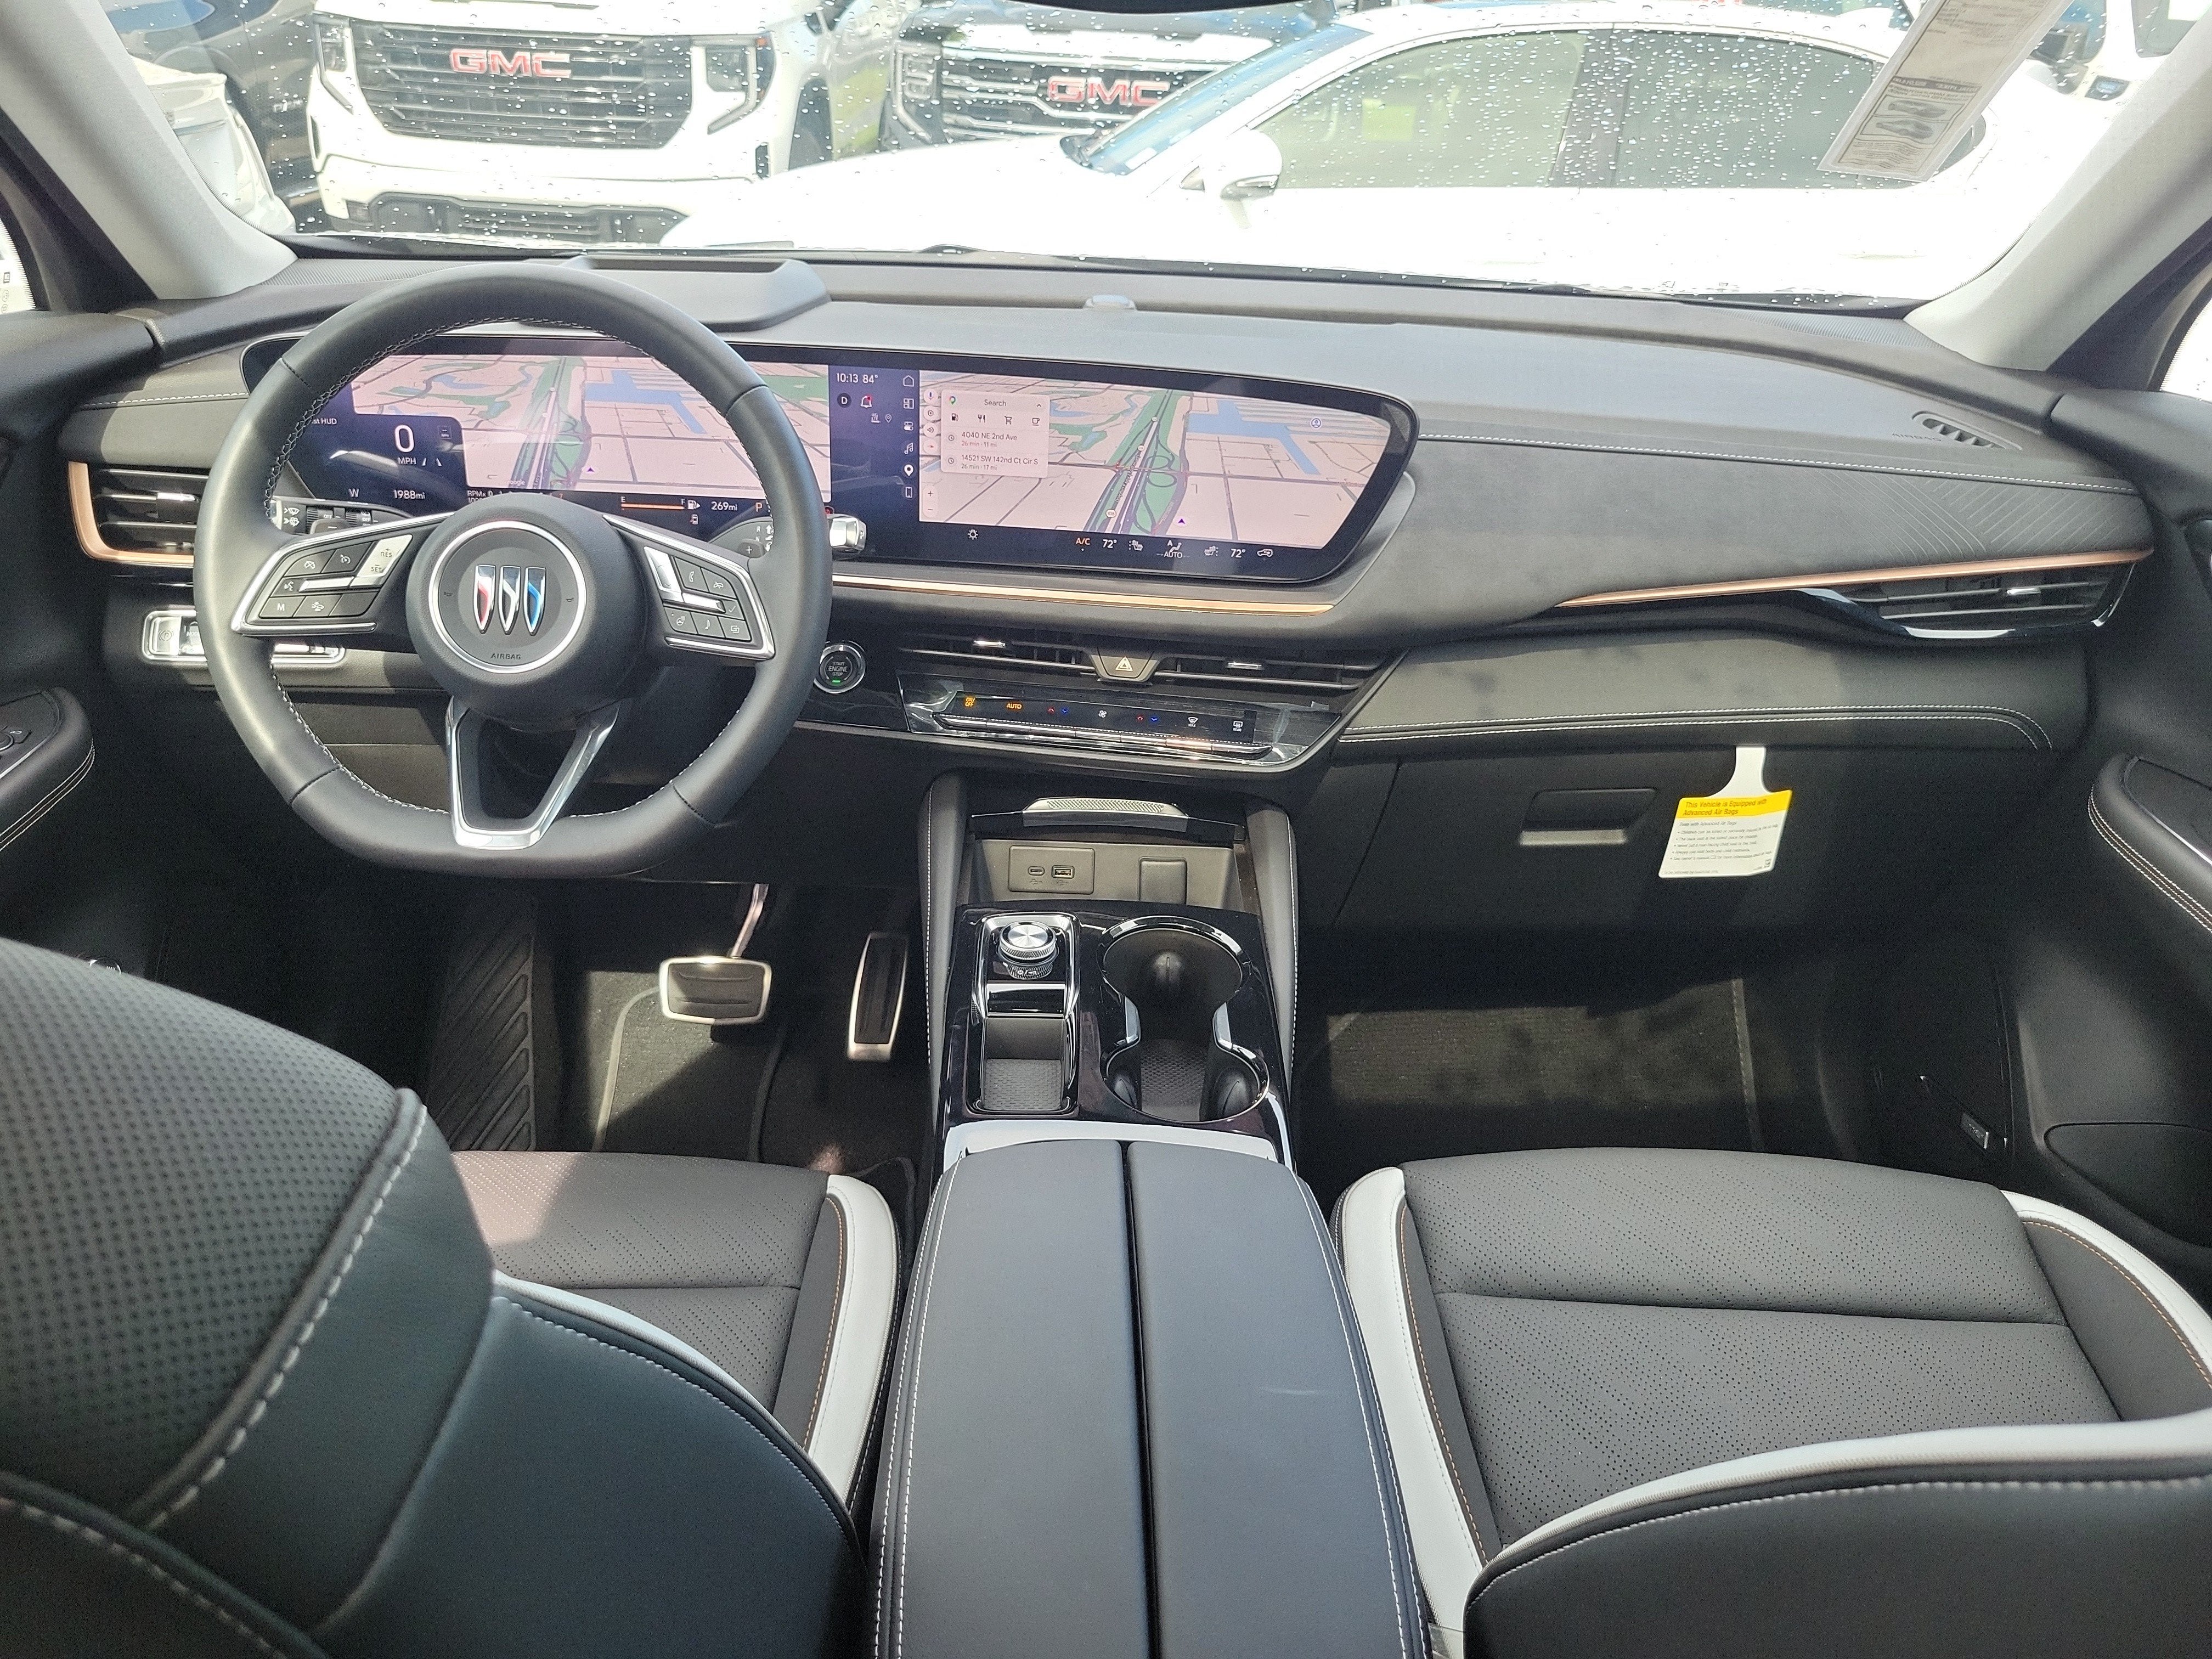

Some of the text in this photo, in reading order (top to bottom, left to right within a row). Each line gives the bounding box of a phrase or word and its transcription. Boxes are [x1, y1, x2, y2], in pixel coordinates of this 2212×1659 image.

[449, 48, 571, 78] GMC
[1048, 76, 1170, 106] GMC
[837, 373, 878, 383] 10:13 84°
[394, 425, 415, 453] 0
[398, 457, 416, 465] MPH
[349, 488, 359, 498] W
[756, 502, 763, 512] P
[1075, 537, 1090, 546] A/C
[1102, 539, 1118, 549] 72°
[1164, 550, 1182, 559] AUTO
[1231, 548, 1246, 558] 72°
[277, 603, 285, 612] M
